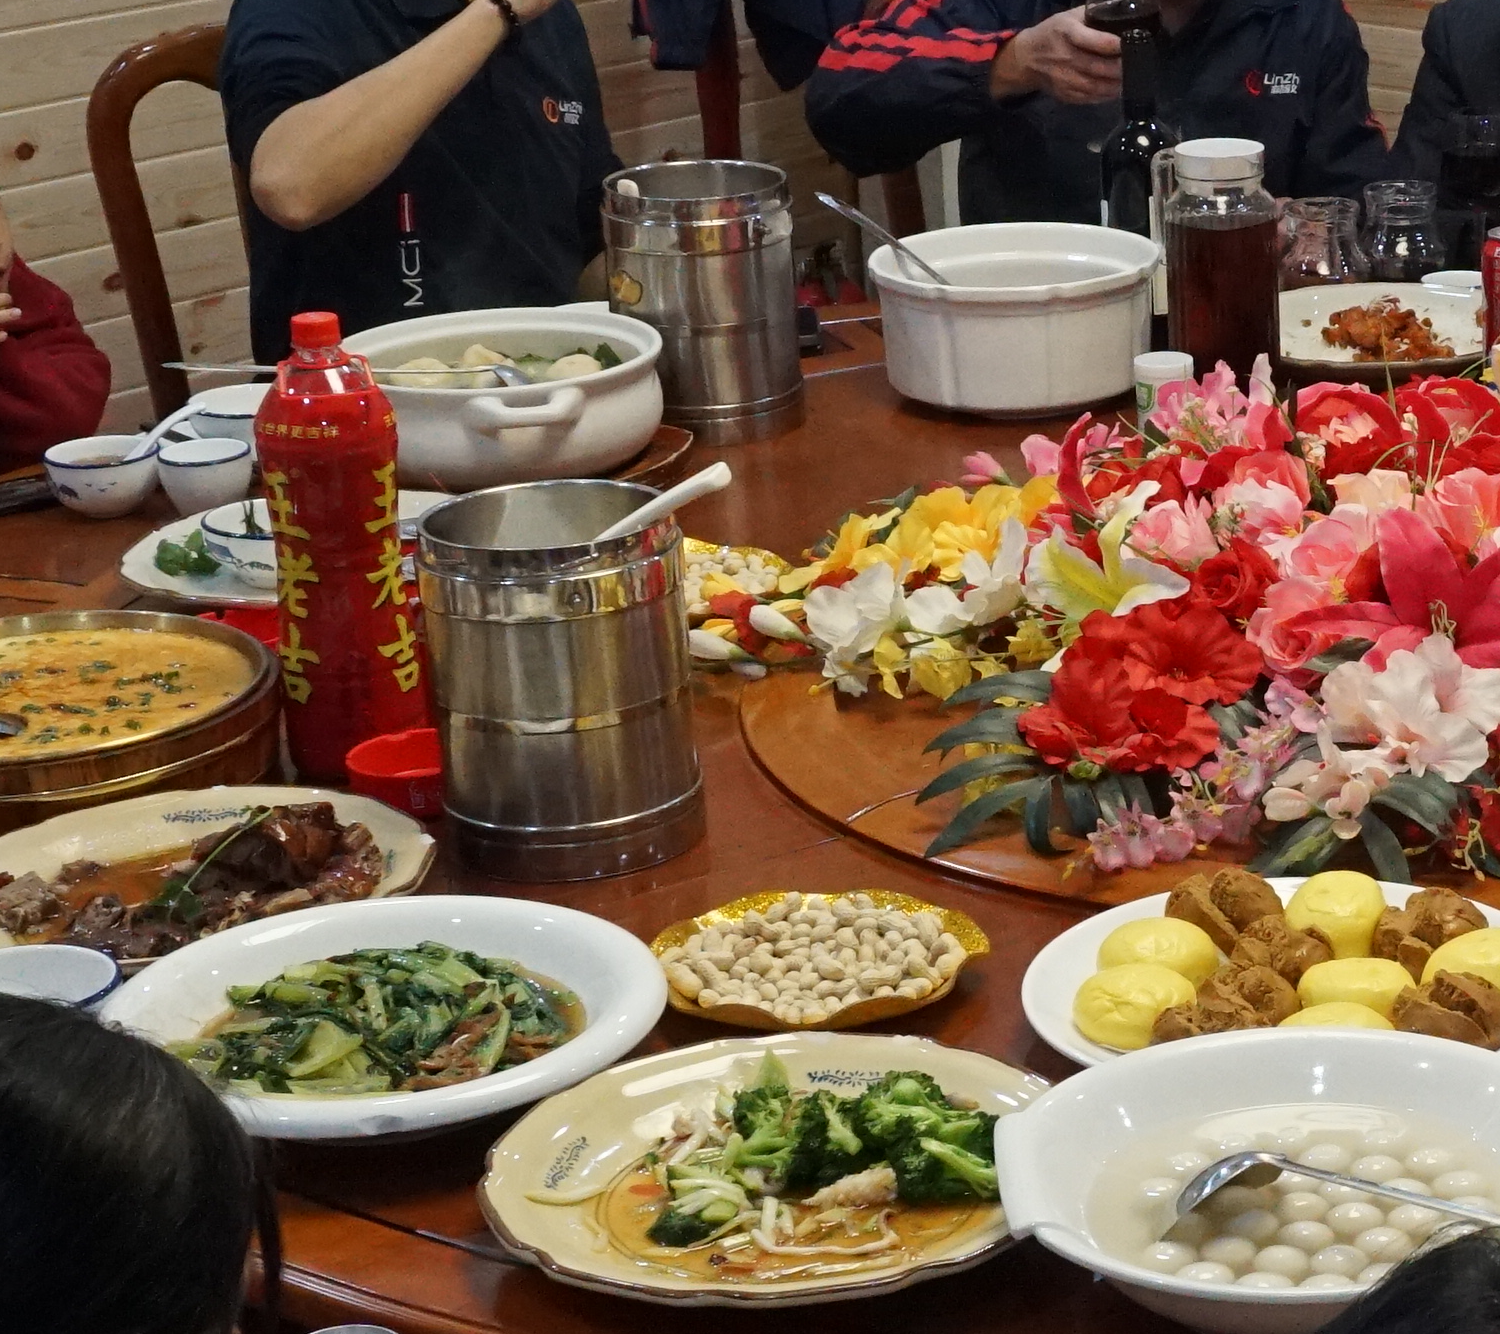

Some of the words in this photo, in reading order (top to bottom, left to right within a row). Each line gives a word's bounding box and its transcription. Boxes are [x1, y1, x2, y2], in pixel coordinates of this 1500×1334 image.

[264, 470, 321, 705] 王老吉
[363, 460, 420, 693] 王老吉
